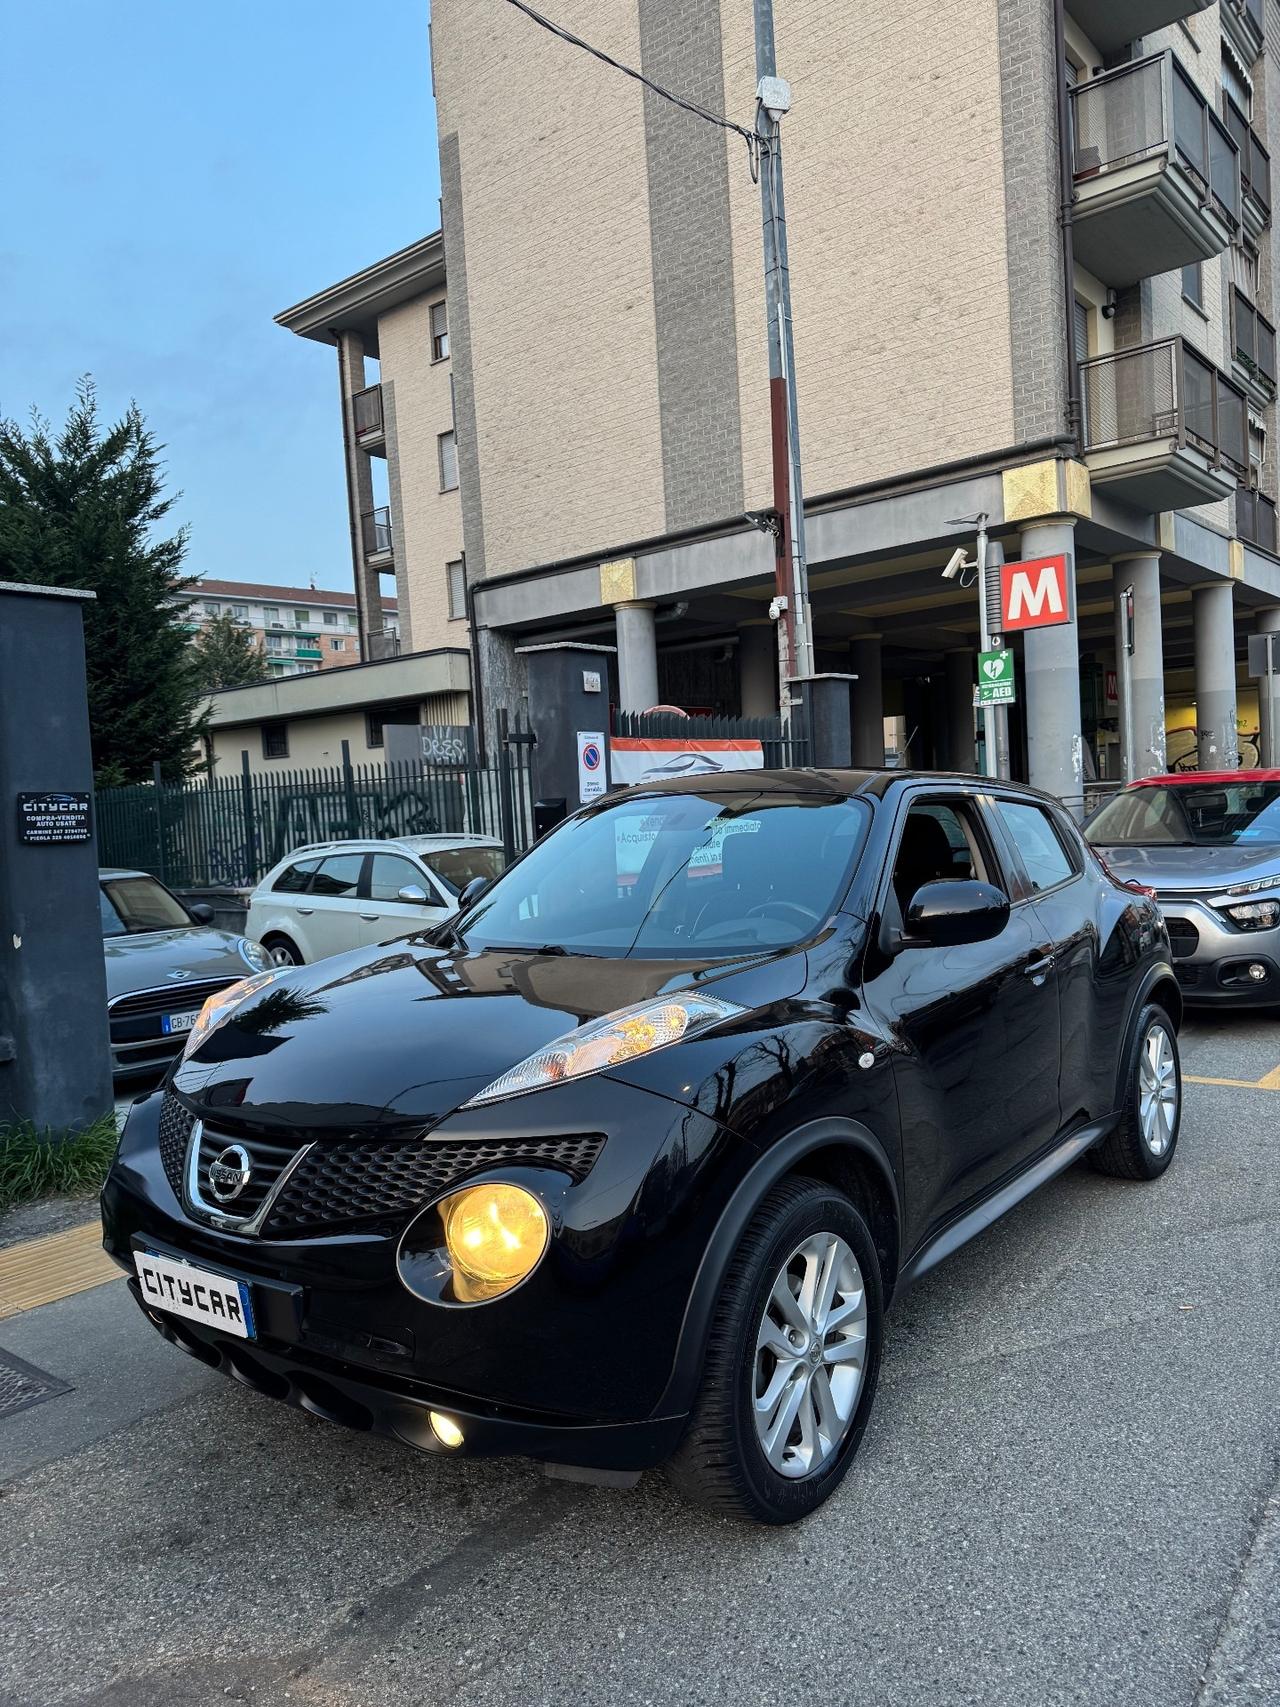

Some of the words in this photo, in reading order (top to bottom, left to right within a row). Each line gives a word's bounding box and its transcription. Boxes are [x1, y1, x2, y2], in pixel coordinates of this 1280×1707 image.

[1007, 566, 1063, 620] M
[992, 687, 1012, 698] AED
[1108, 674, 1118, 694] M
[22, 803, 88, 812] CITYCAR
[210, 1165, 243, 1182] NISSAN
[143, 1268, 242, 1323] CITYCAR
